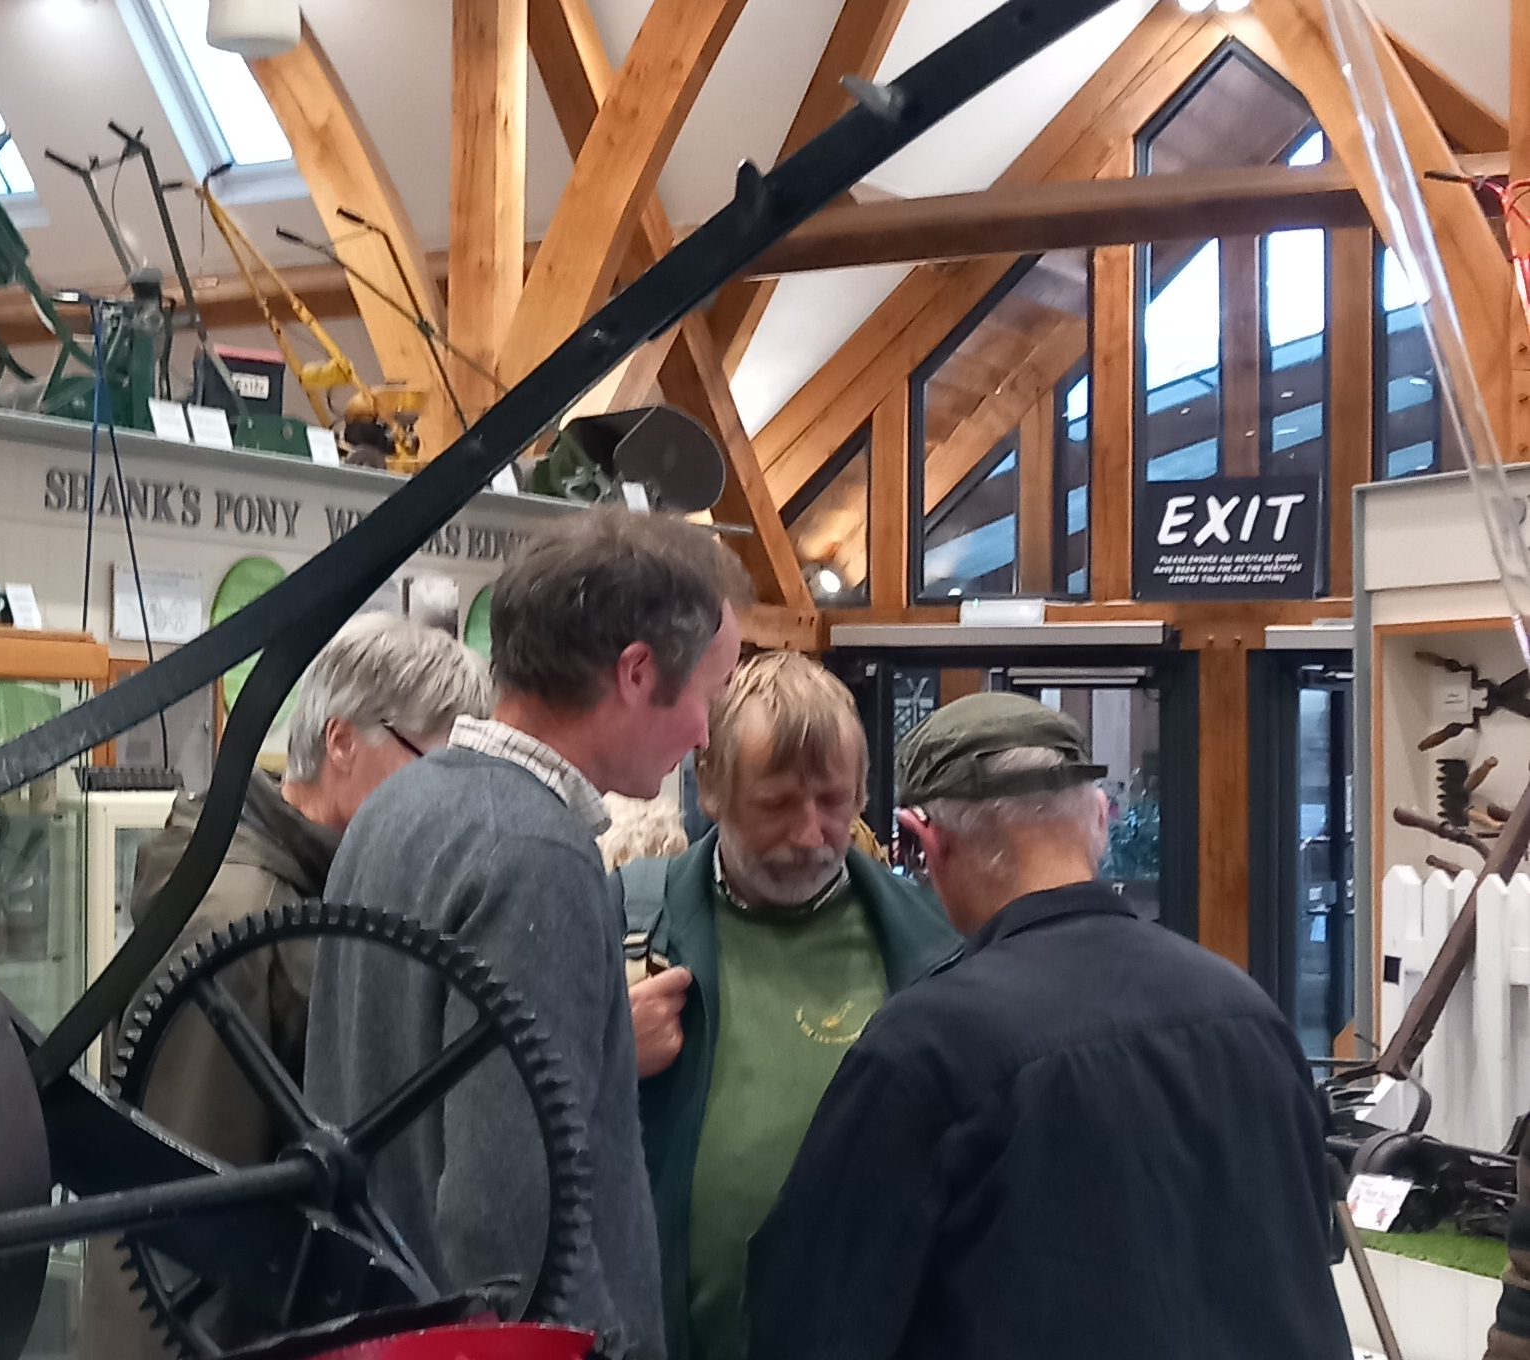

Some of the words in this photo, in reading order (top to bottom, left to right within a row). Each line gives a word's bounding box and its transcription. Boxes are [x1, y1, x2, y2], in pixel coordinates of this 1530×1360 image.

[44, 466, 202, 530] SHANK'S
[214, 488, 302, 538] PONY
[1157, 493, 1306, 547] EXIT
